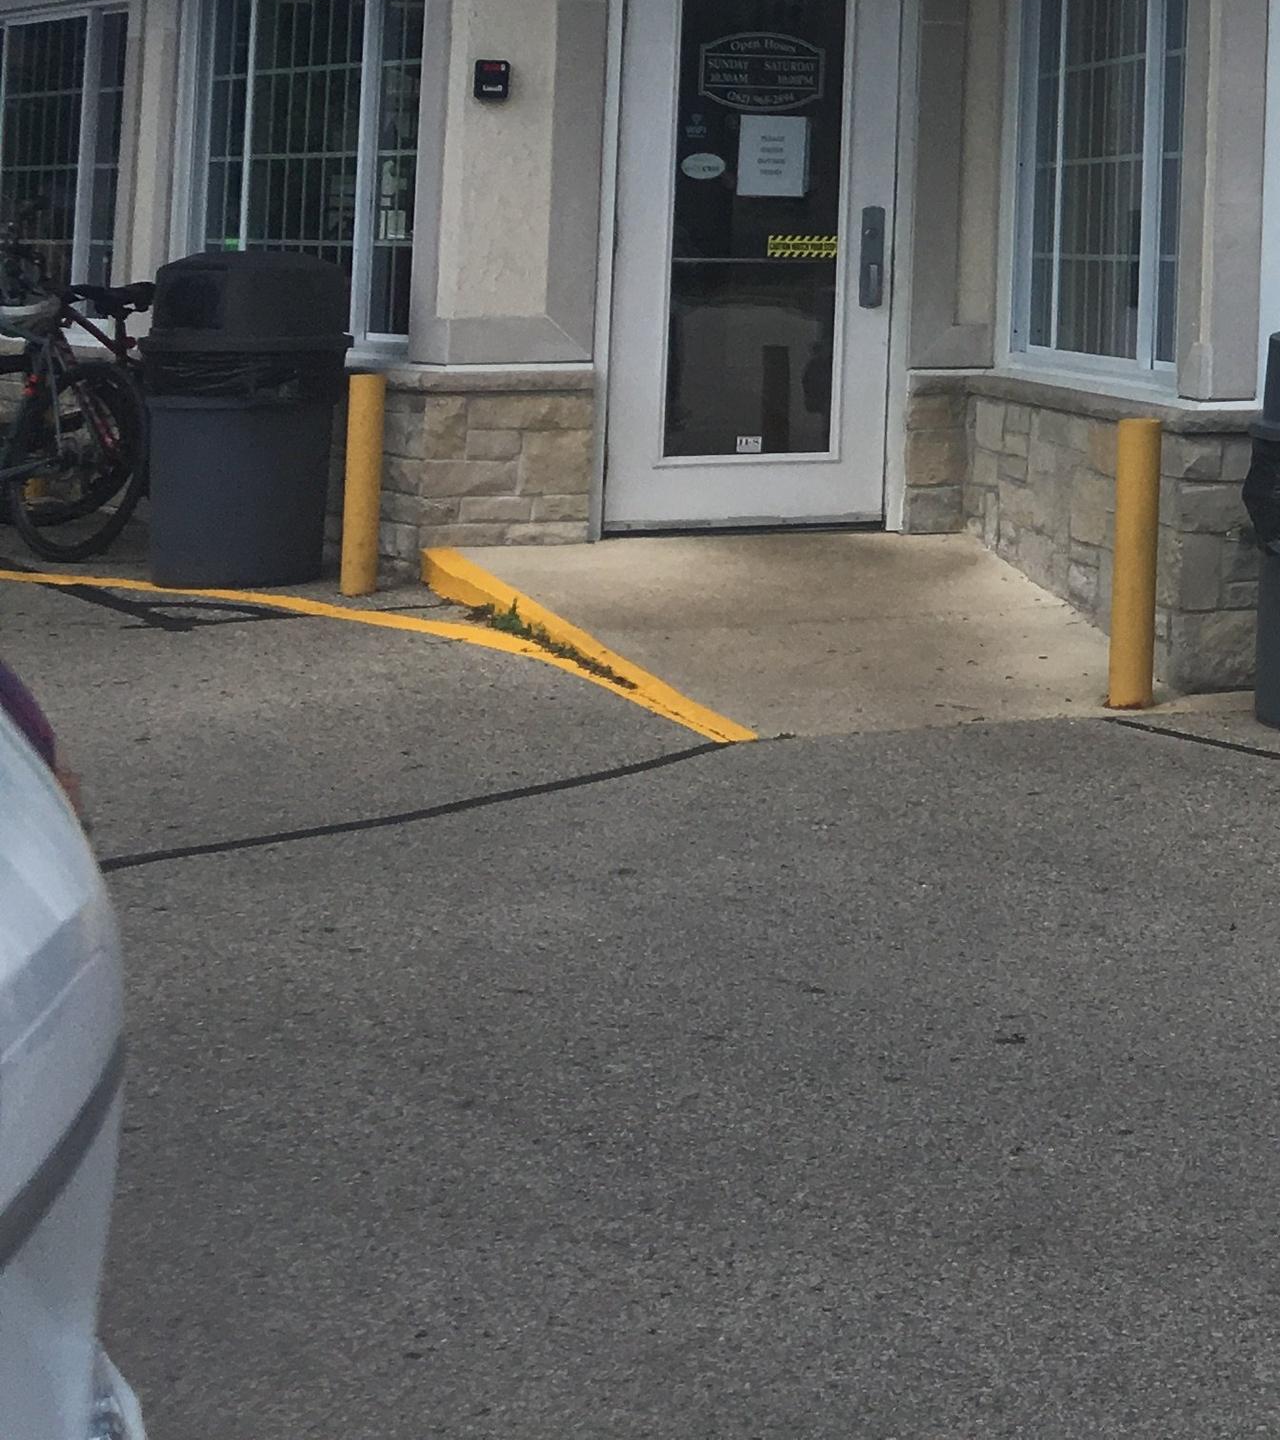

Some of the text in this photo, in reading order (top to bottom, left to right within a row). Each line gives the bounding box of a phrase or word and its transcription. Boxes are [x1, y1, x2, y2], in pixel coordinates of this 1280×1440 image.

[730, 38, 797, 54] Open Hours
[707, 58, 816, 72] SUNDAY SATURDAY
